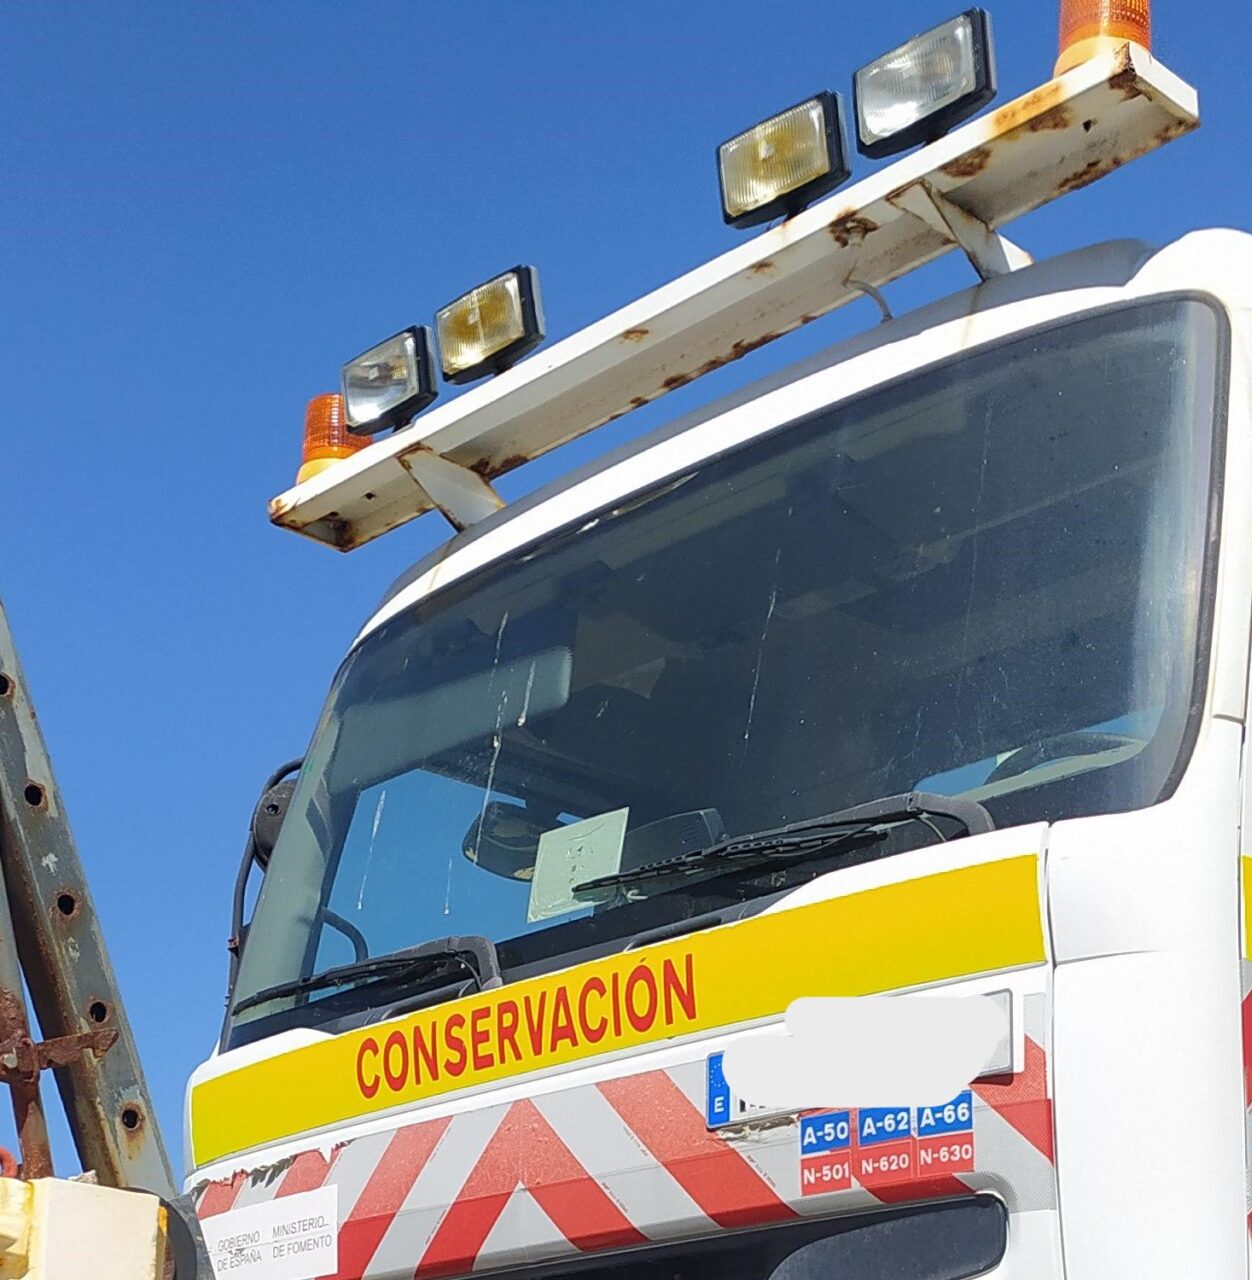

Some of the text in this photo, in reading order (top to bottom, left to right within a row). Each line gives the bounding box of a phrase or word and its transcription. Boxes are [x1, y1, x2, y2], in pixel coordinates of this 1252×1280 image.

[356, 954, 697, 1099] CONSERVACIÓN
[713, 1095, 724, 1113] E
[919, 1102, 971, 1128] A-66
[802, 1121, 849, 1146] A-50
[861, 1111, 909, 1137] A-62
[860, 1153, 910, 1175] N-620
[919, 1144, 973, 1166] N-630
[802, 1166, 850, 1184] N-501
[272, 1215, 326, 1239] MINISTERIO
[217, 1230, 261, 1252] GOBIERNO
[272, 1234, 333, 1259] DE FOMENTO
[217, 1250, 263, 1272] DE ESPAÑA
